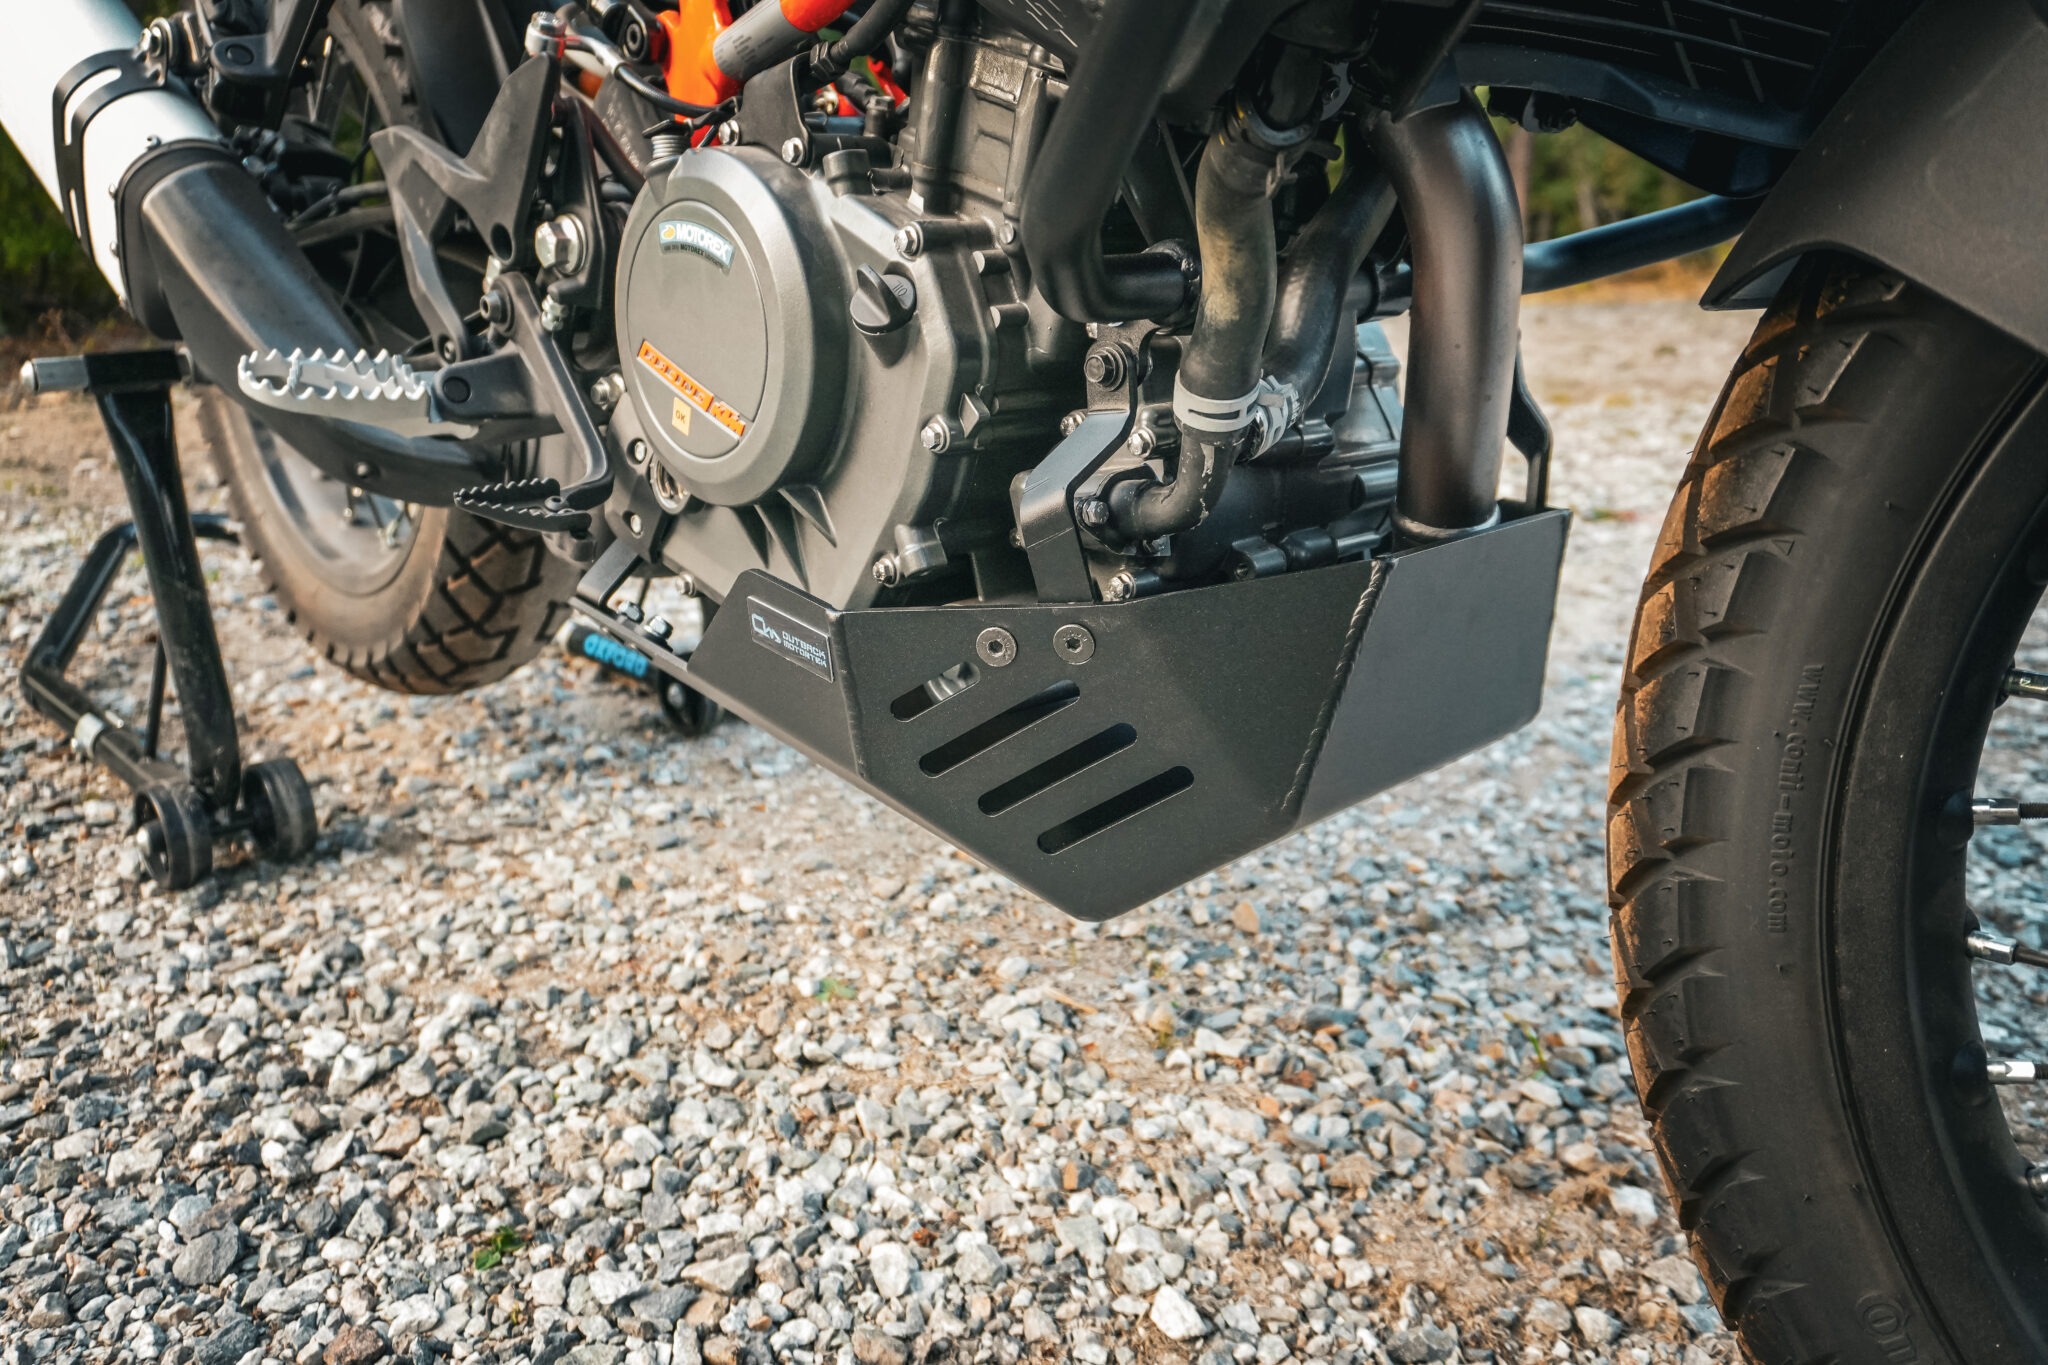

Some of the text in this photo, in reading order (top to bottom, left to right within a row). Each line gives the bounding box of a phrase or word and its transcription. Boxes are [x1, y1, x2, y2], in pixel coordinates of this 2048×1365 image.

[676, 223, 729, 261] MOTOREX
[680, 244, 705, 256] MOTOREX
[675, 410, 686, 422] OK
[709, 401, 746, 436] KTM
[583, 633, 649, 677] OXFORD
[782, 631, 826, 660] OUTBACK
[783, 640, 827, 668] MOTORTEK
[1767, 663, 1825, 933] www.conti-moto.com
